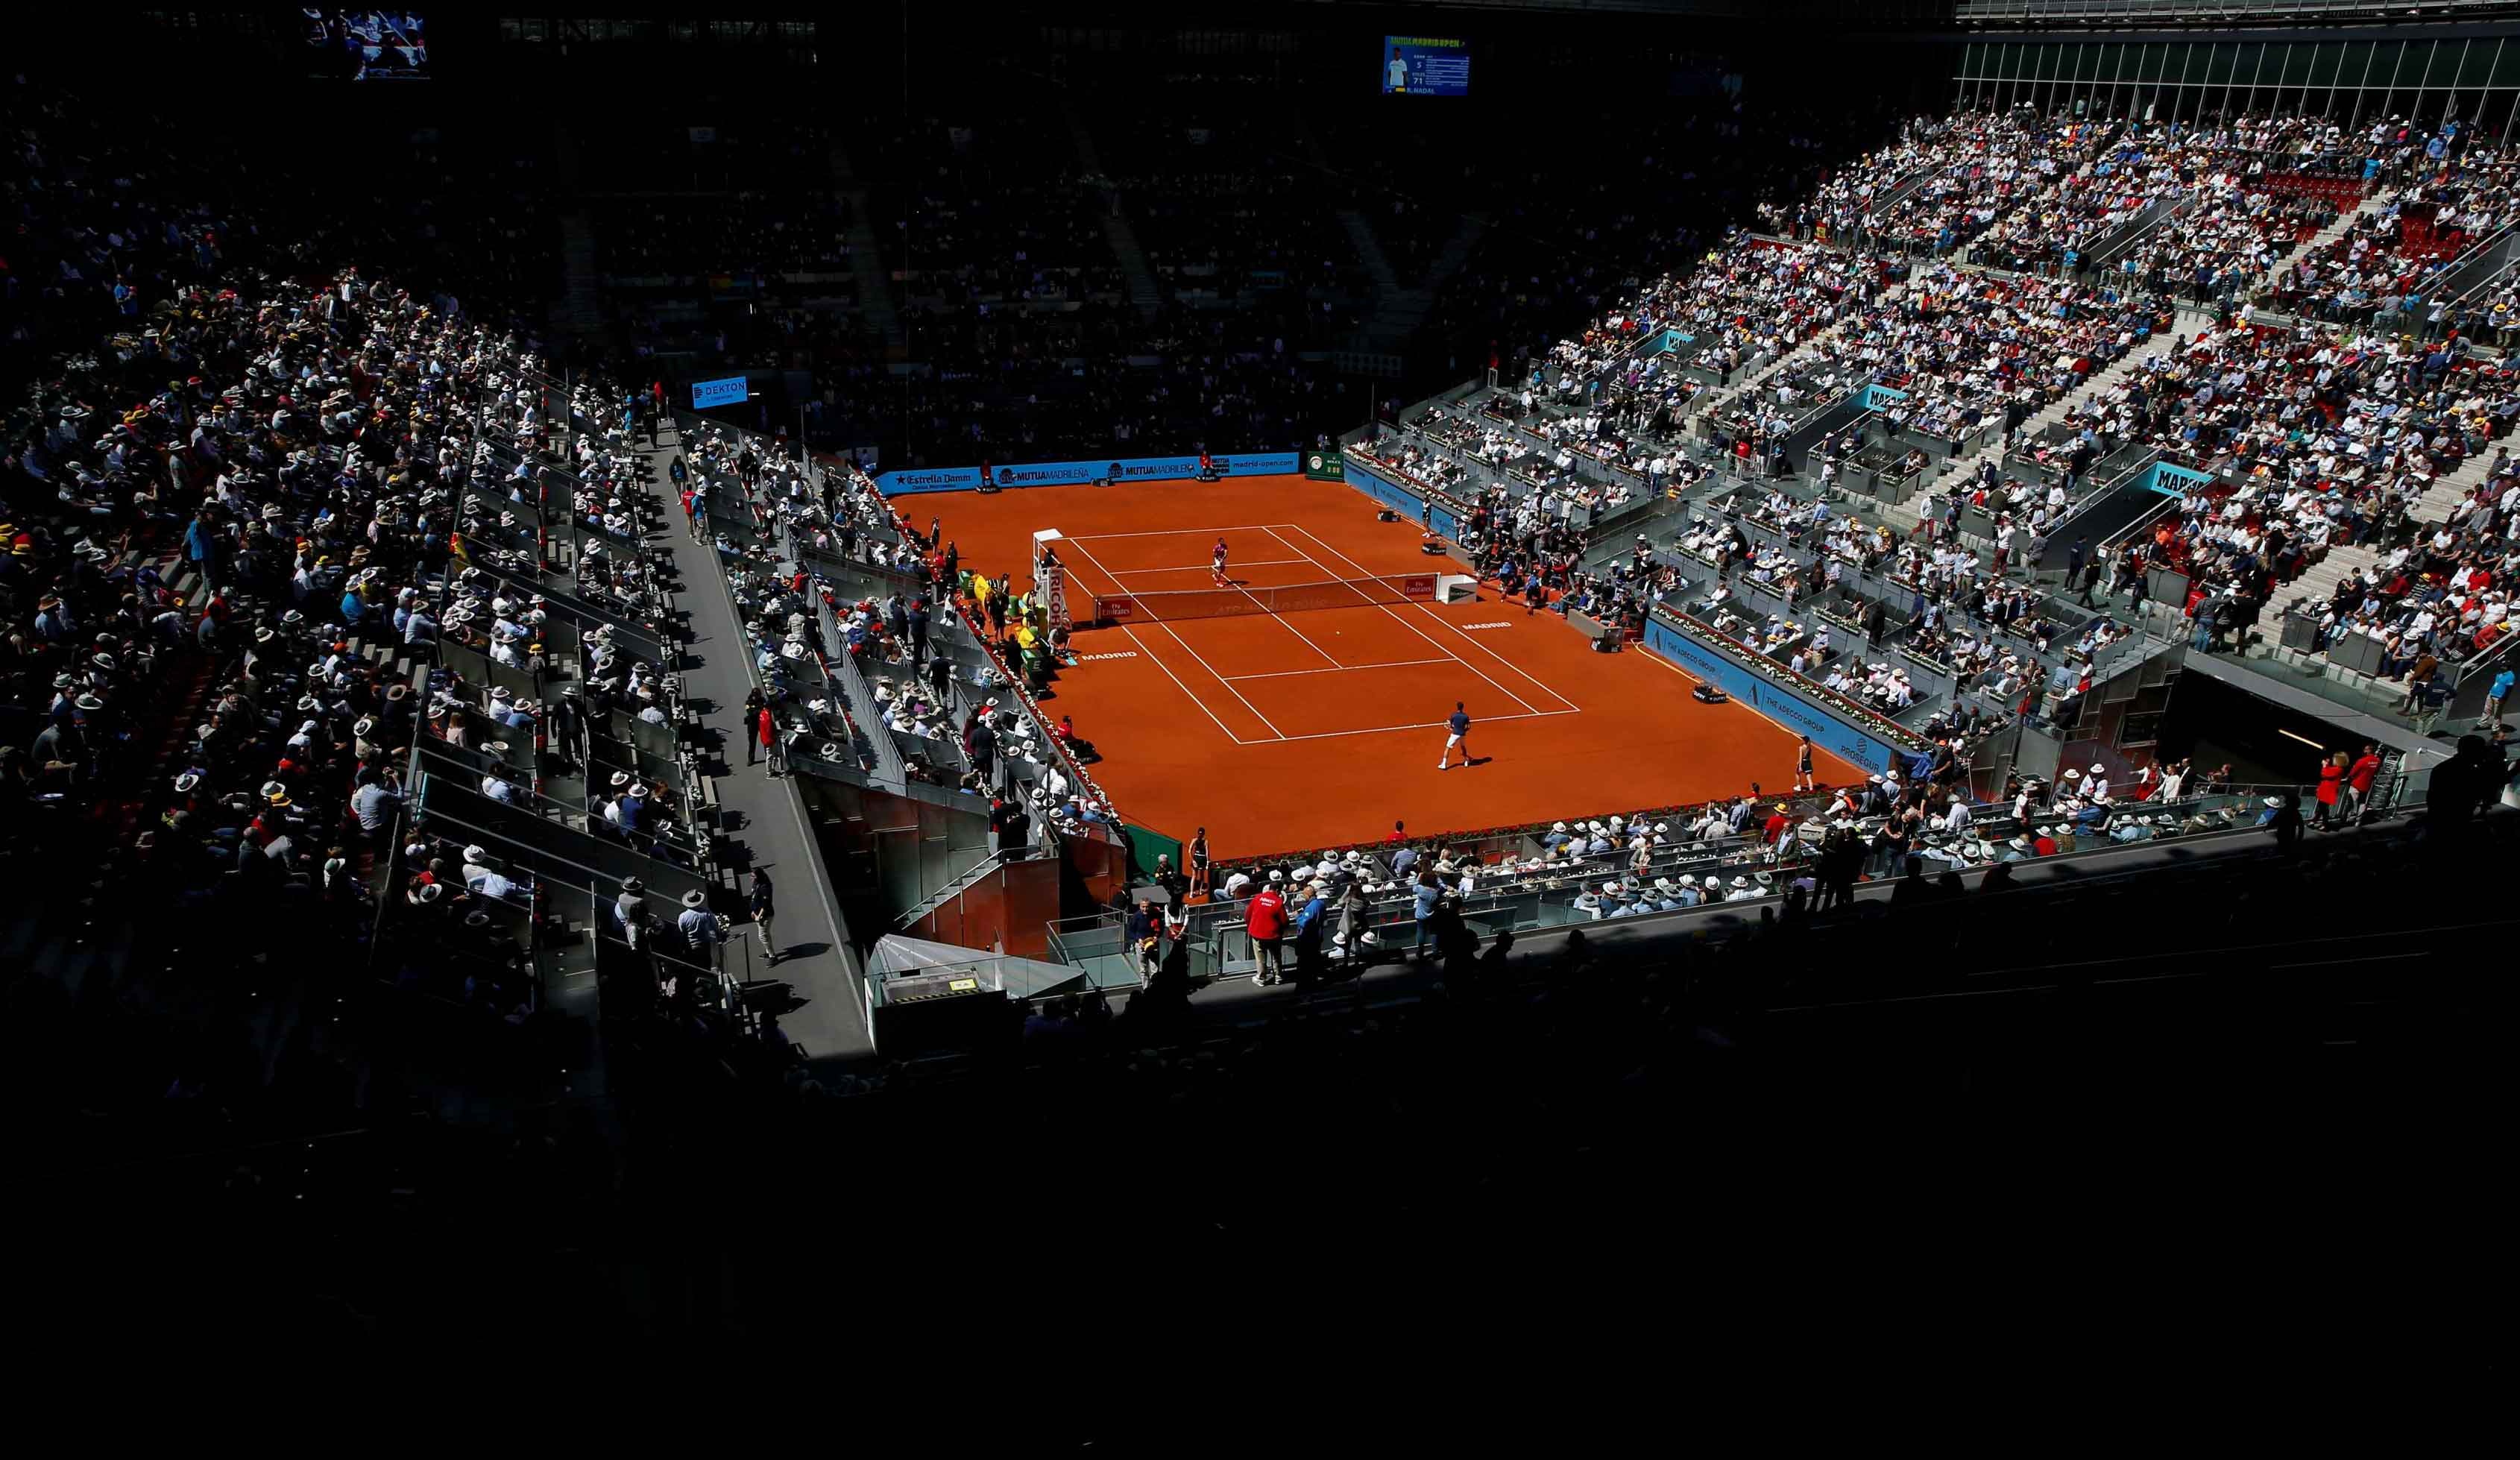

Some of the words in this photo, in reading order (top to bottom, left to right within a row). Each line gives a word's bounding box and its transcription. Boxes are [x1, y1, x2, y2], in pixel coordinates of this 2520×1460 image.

[705, 382, 746, 395] DEKTON
[907, 473, 942, 485] Estrella
[944, 473, 971, 483] Damm
[1050, 576, 1061, 626] RICOH
[1461, 621, 1513, 630] MADRID
[1081, 651, 1138, 661] MADRID
[1678, 648, 1698, 664] ADECCO
[1766, 696, 1778, 708] THE
[1778, 705, 1803, 722] ADECCO
[1803, 717, 1825, 734] GROUP
[1840, 745, 1880, 775] PROSEGUR
